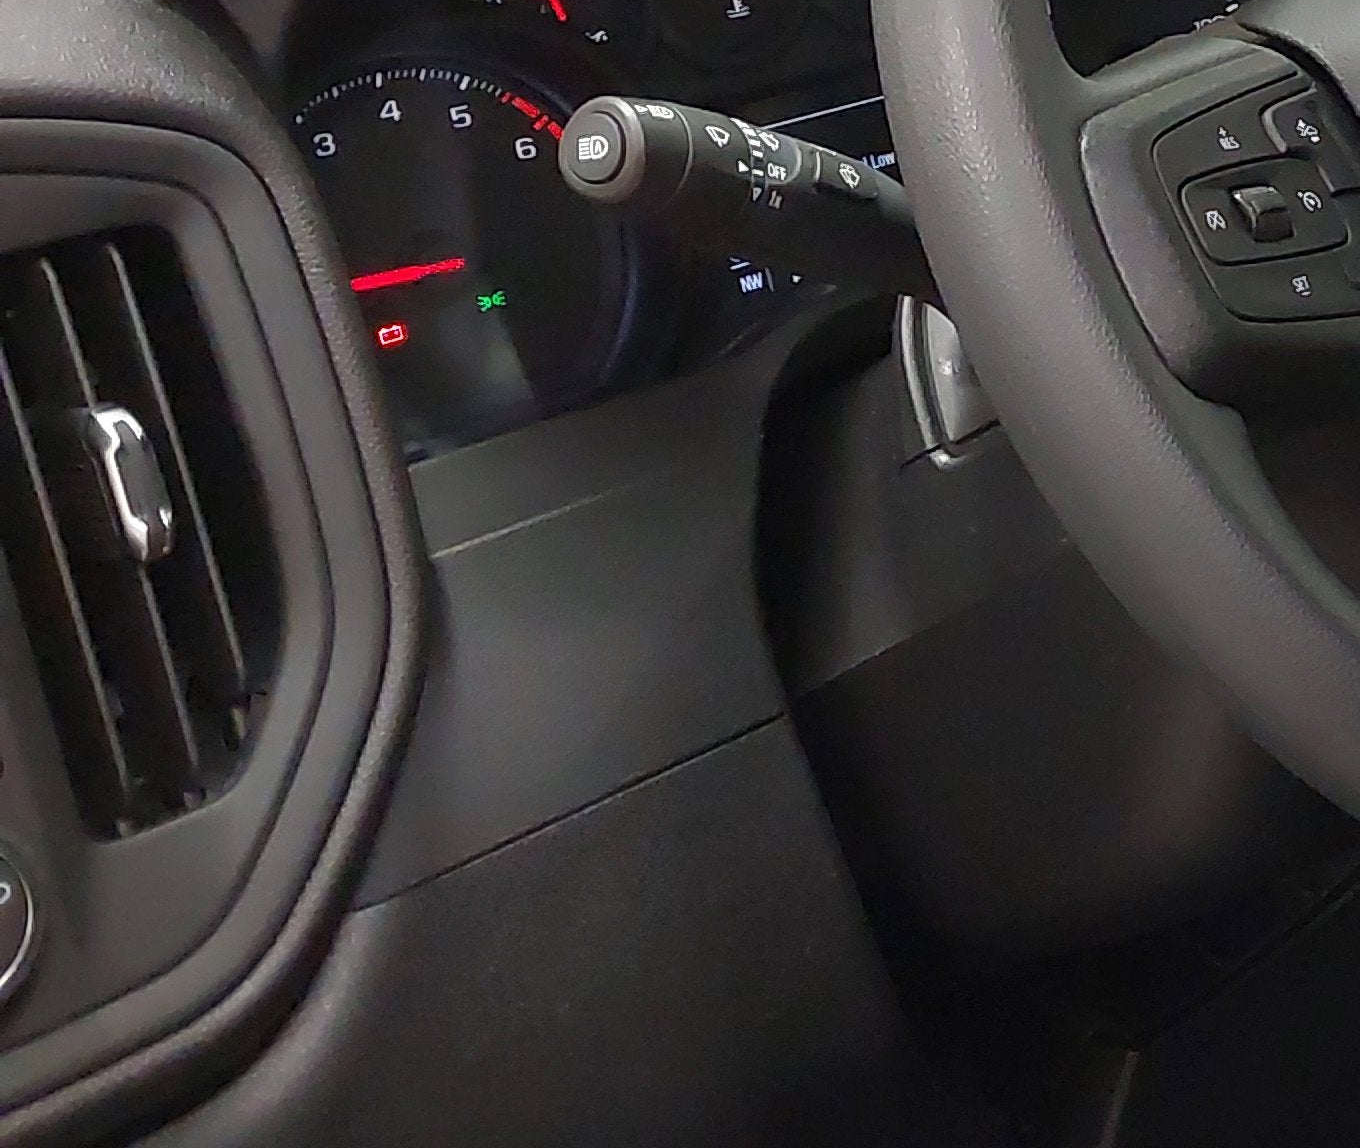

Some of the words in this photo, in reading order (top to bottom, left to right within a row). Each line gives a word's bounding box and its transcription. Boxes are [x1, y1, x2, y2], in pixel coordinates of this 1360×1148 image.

[379, 99, 402, 123] 4
[449, 104, 473, 129] 5
[313, 132, 337, 157] 3
[514, 137, 538, 161] 6
[767, 162, 788, 181] OFF
[739, 271, 763, 293] NW
